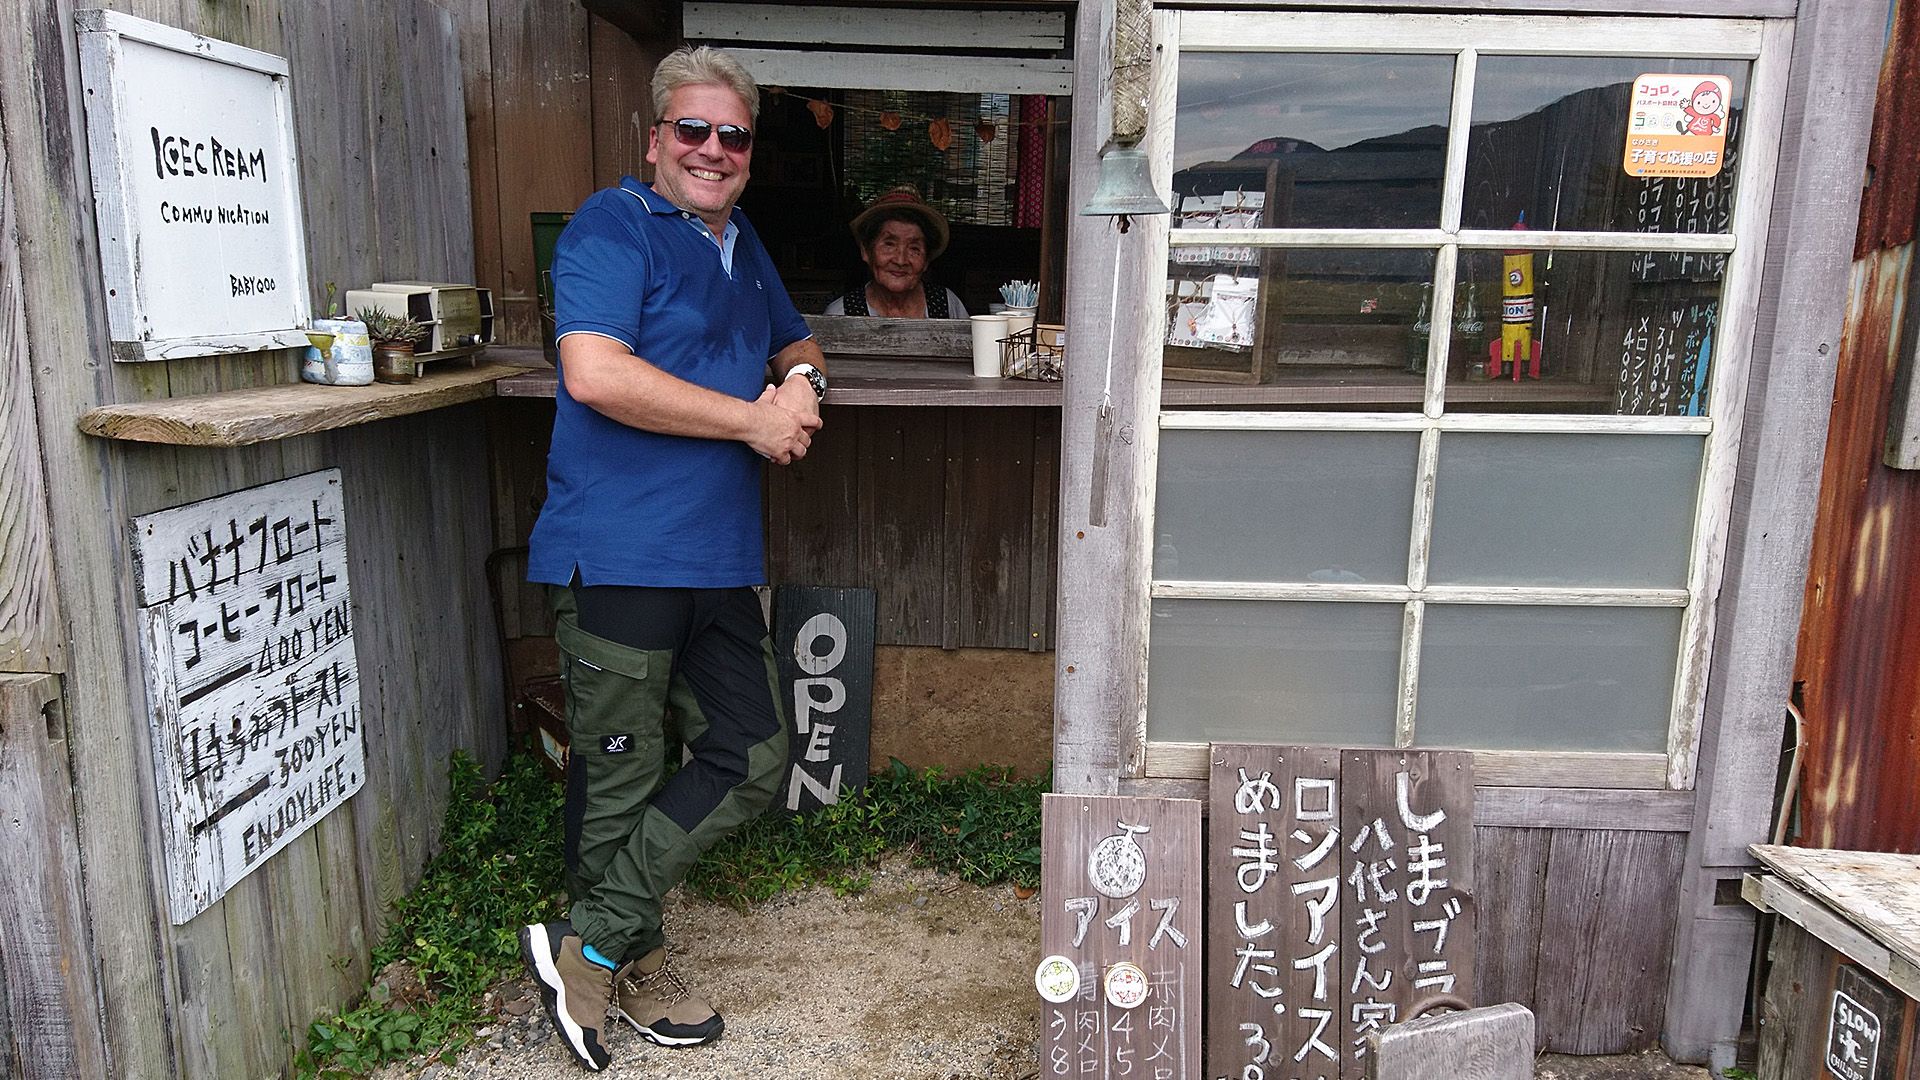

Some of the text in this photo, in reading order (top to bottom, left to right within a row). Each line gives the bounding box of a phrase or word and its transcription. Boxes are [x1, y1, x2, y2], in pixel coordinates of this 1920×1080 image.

[1631, 148, 1719, 166] 子育て応援の店
[168, 499, 333, 605] バナナフロート
[178, 561, 338, 670] コーヒーフロート
[786, 612, 848, 811] OPEN
[1064, 896, 1189, 951] アイス
[1839, 1002, 1877, 1043] SLOW
